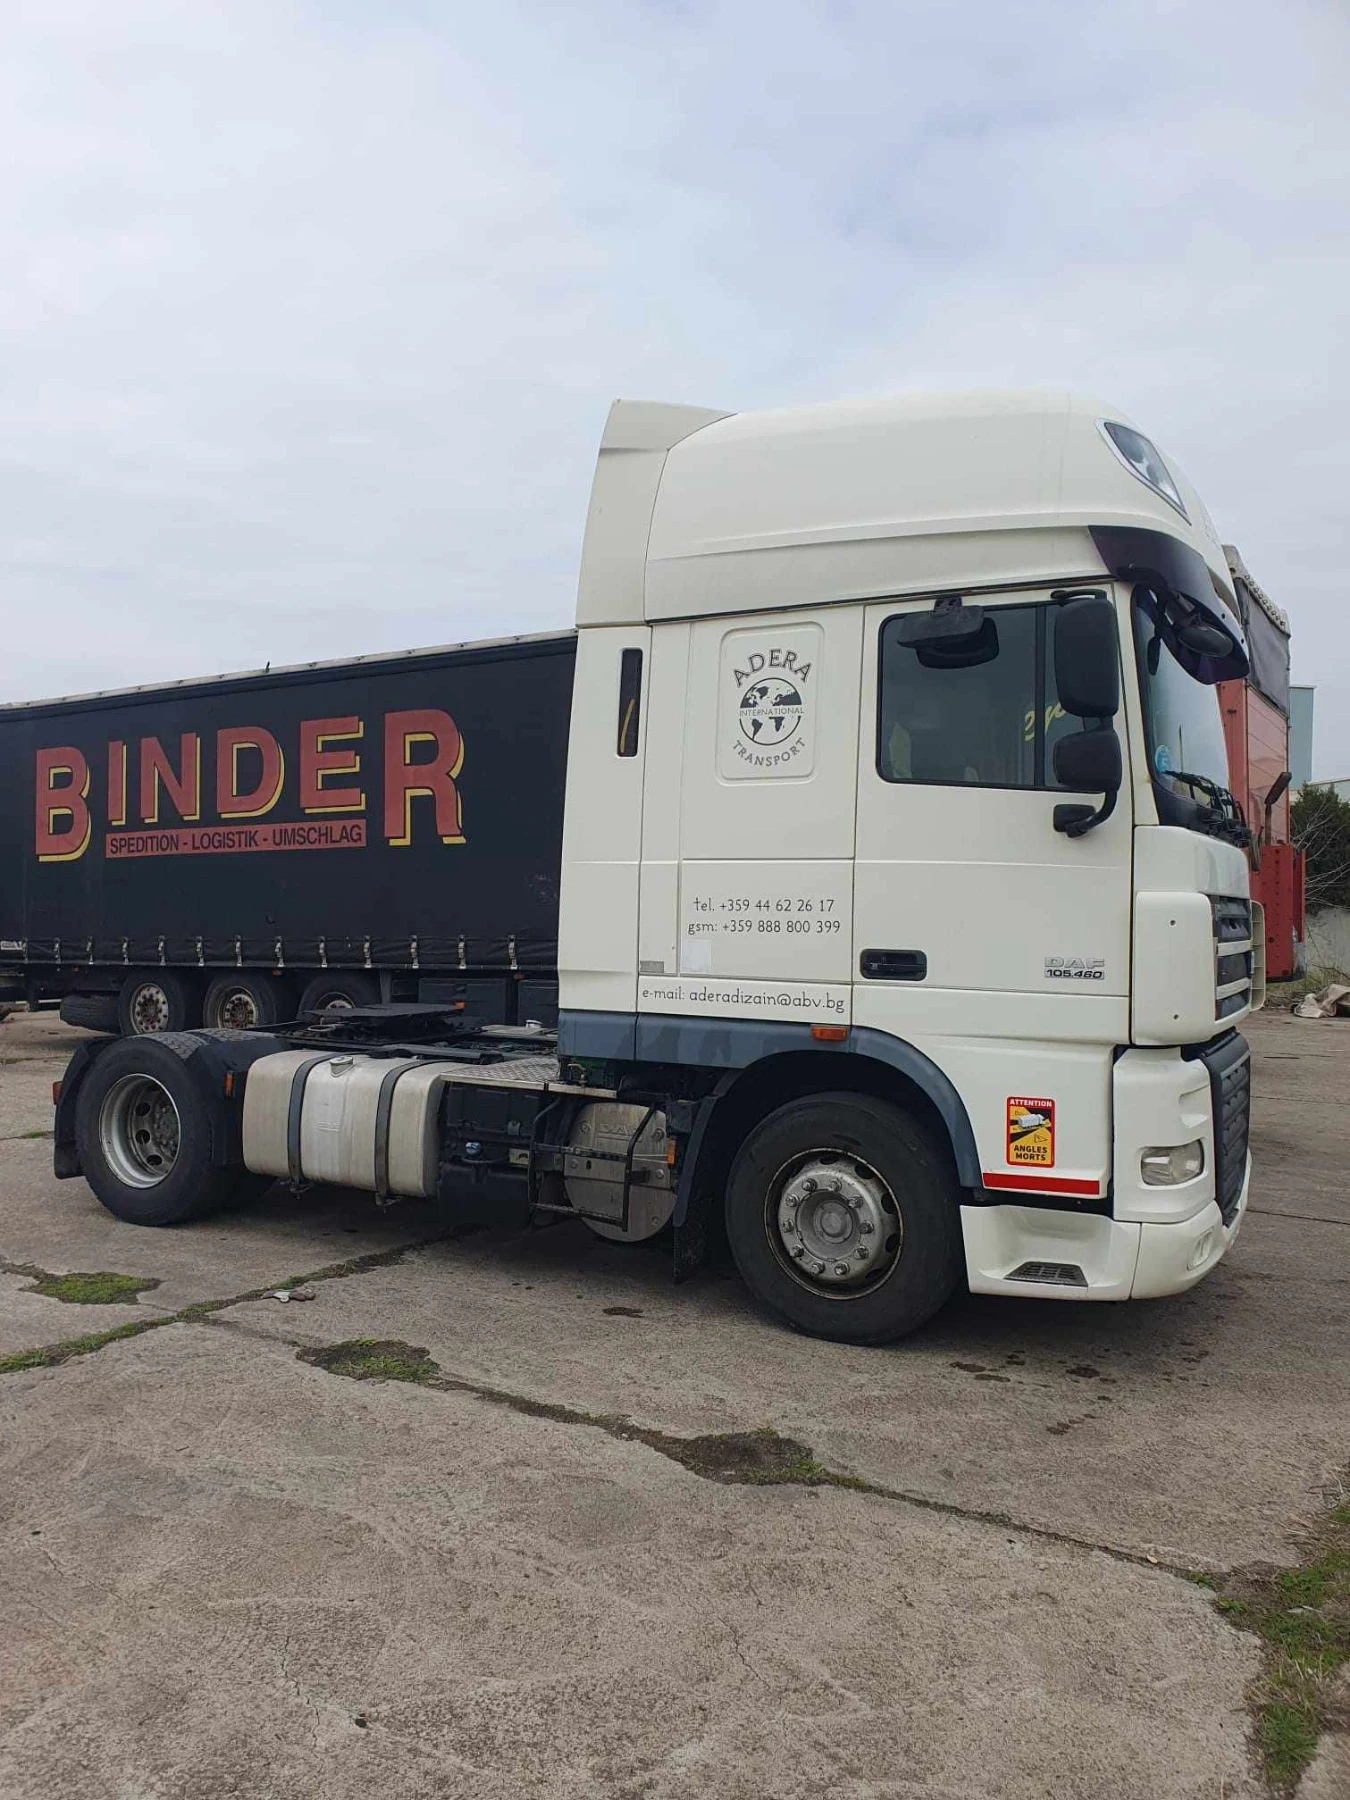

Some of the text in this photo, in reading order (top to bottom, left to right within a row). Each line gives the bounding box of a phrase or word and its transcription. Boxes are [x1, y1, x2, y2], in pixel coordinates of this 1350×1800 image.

[733, 649, 812, 687] ADERA
[739, 706, 805, 717] INTERNATIONAL
[732, 738, 806, 767] TRANSPORT
[35, 709, 467, 862] BINDER
[110, 833, 180, 855] SPEDITION
[191, 829, 259, 851] LOGISTIK
[272, 824, 363, 847] UMSCHLAG
[693, 897, 835, 912] tel. +359 44 62 26 17
[688, 920, 841, 935] gsm: +359 888 800 399
[1044, 957, 1105, 969] DAF
[1046, 969, 1103, 979] 105.460
[689, 987, 845, 1013] aderadizain@abv.bg
[1010, 1098, 1053, 1108] ATTENTION
[1013, 1144, 1048, 1154] ANGLES
[1015, 1152, 1046, 1162] MORTS
